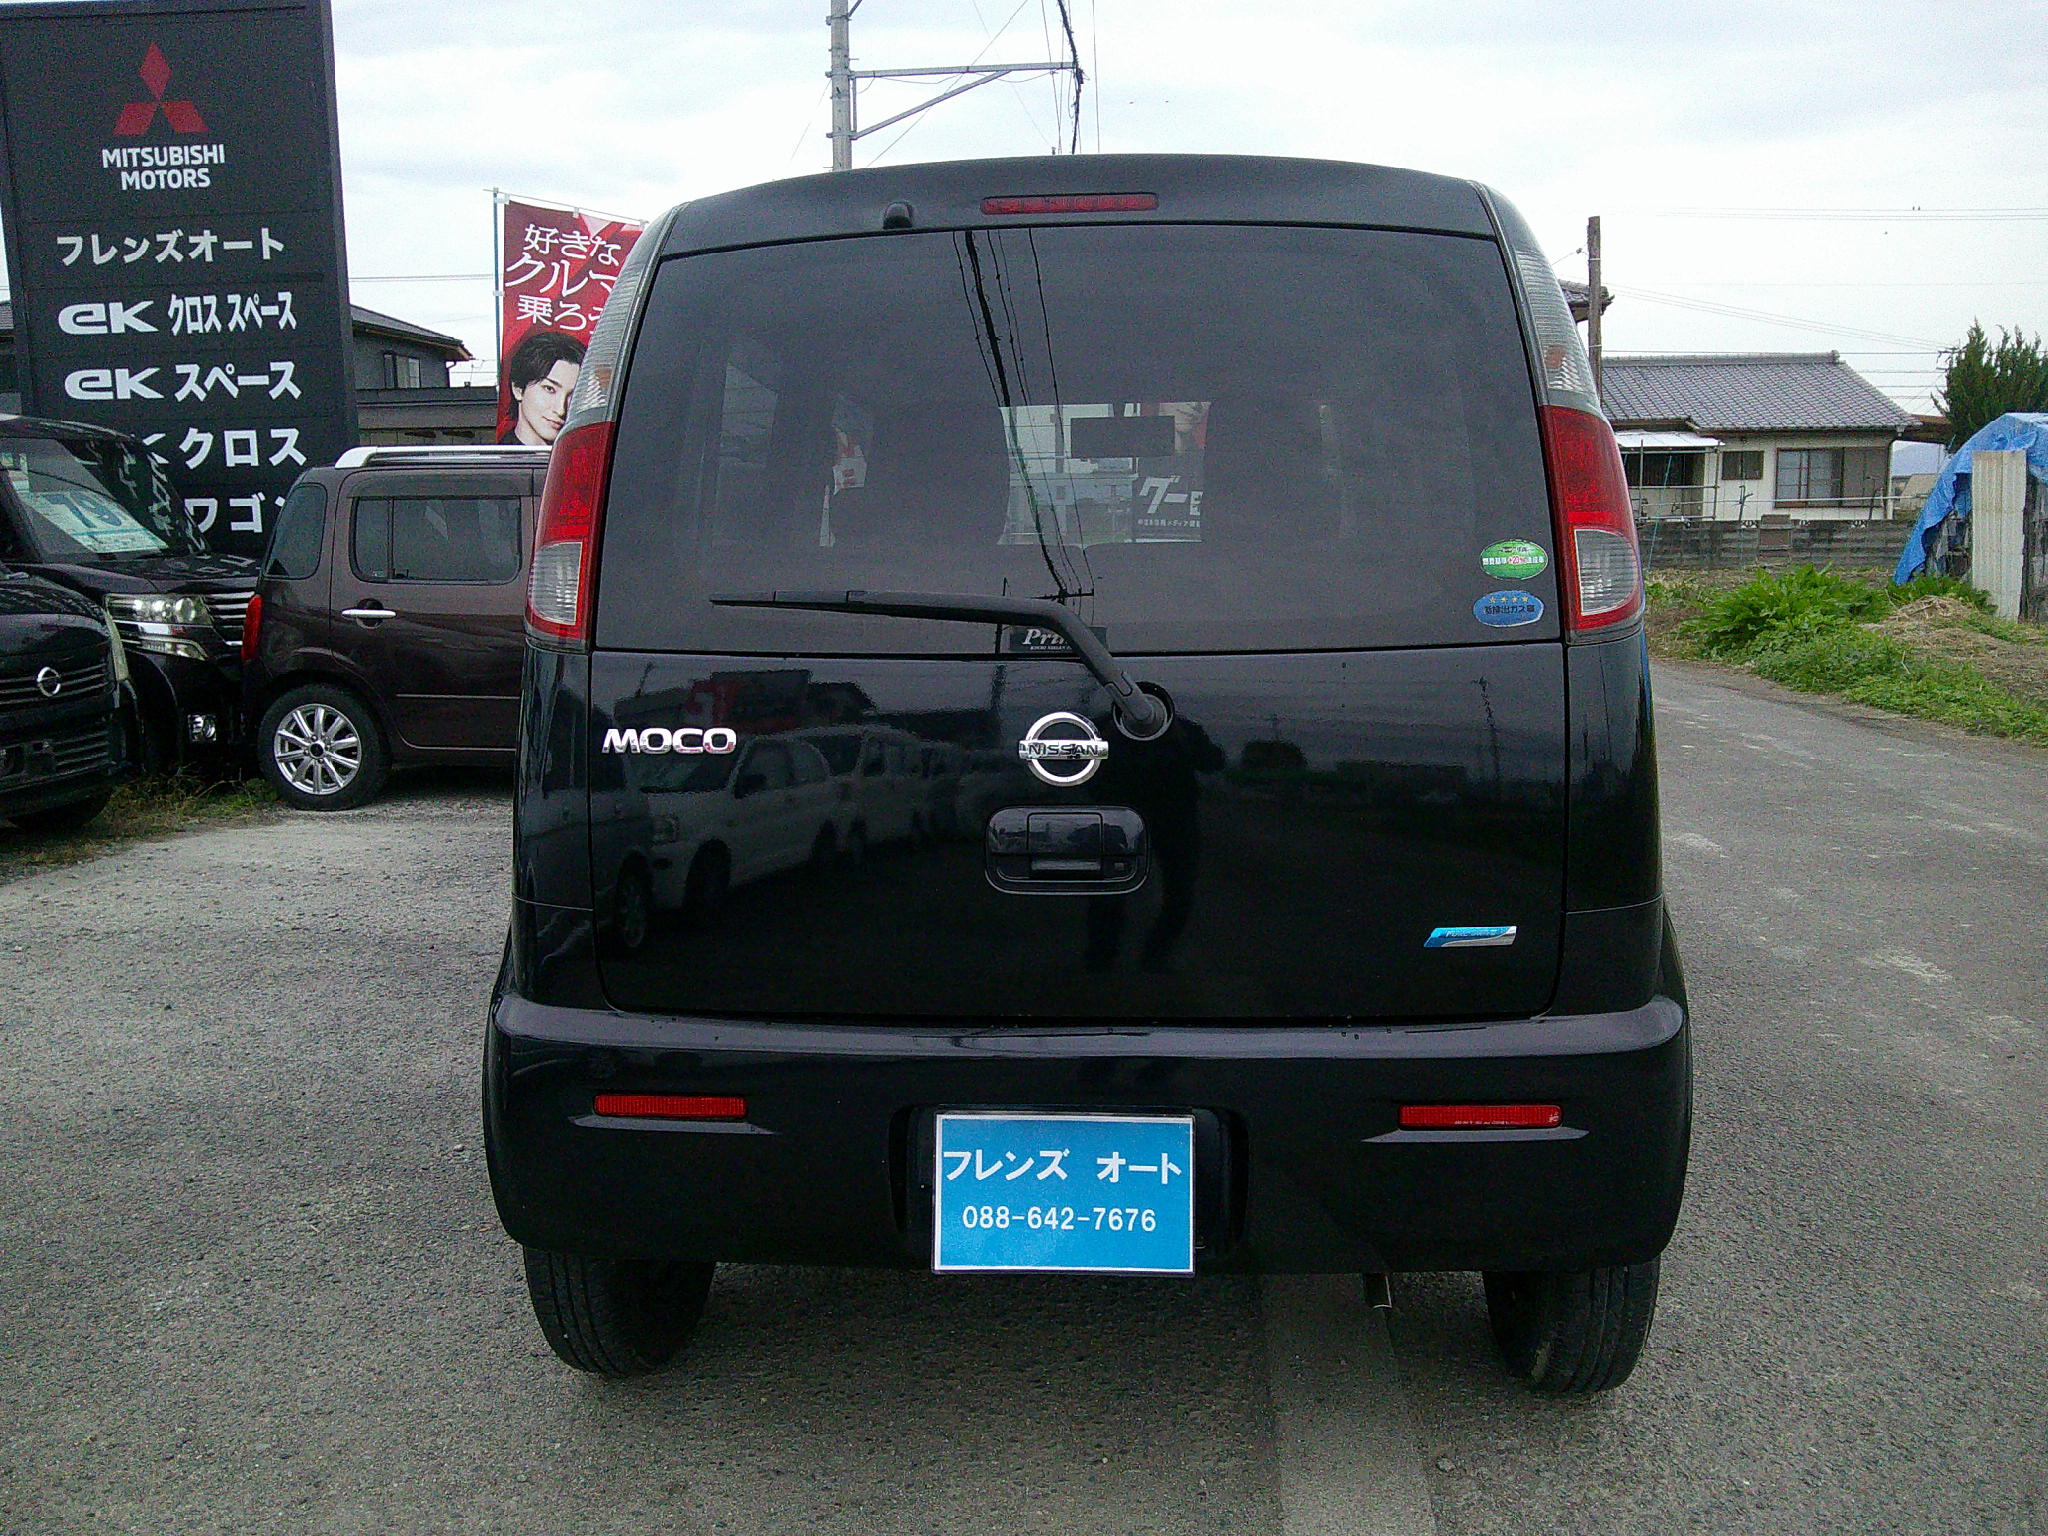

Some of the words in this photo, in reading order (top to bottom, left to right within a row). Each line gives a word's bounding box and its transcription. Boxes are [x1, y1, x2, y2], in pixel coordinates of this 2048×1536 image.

[102, 143, 226, 168] MITSUBISHI
[121, 168, 211, 190] MOTORS
[57, 227, 285, 266] フレンズオート
[523, 223, 622, 267] 好きな
[174, 361, 301, 401] スペース
[184, 492, 285, 534] ワゴ
[601, 727, 737, 754] MOCO
[1028, 743, 1099, 756] NISSAN
[943, 1148, 1070, 1181] フレンズ
[1096, 1151, 1183, 1185] オート
[962, 1205, 1157, 1232] 088-642-7676
